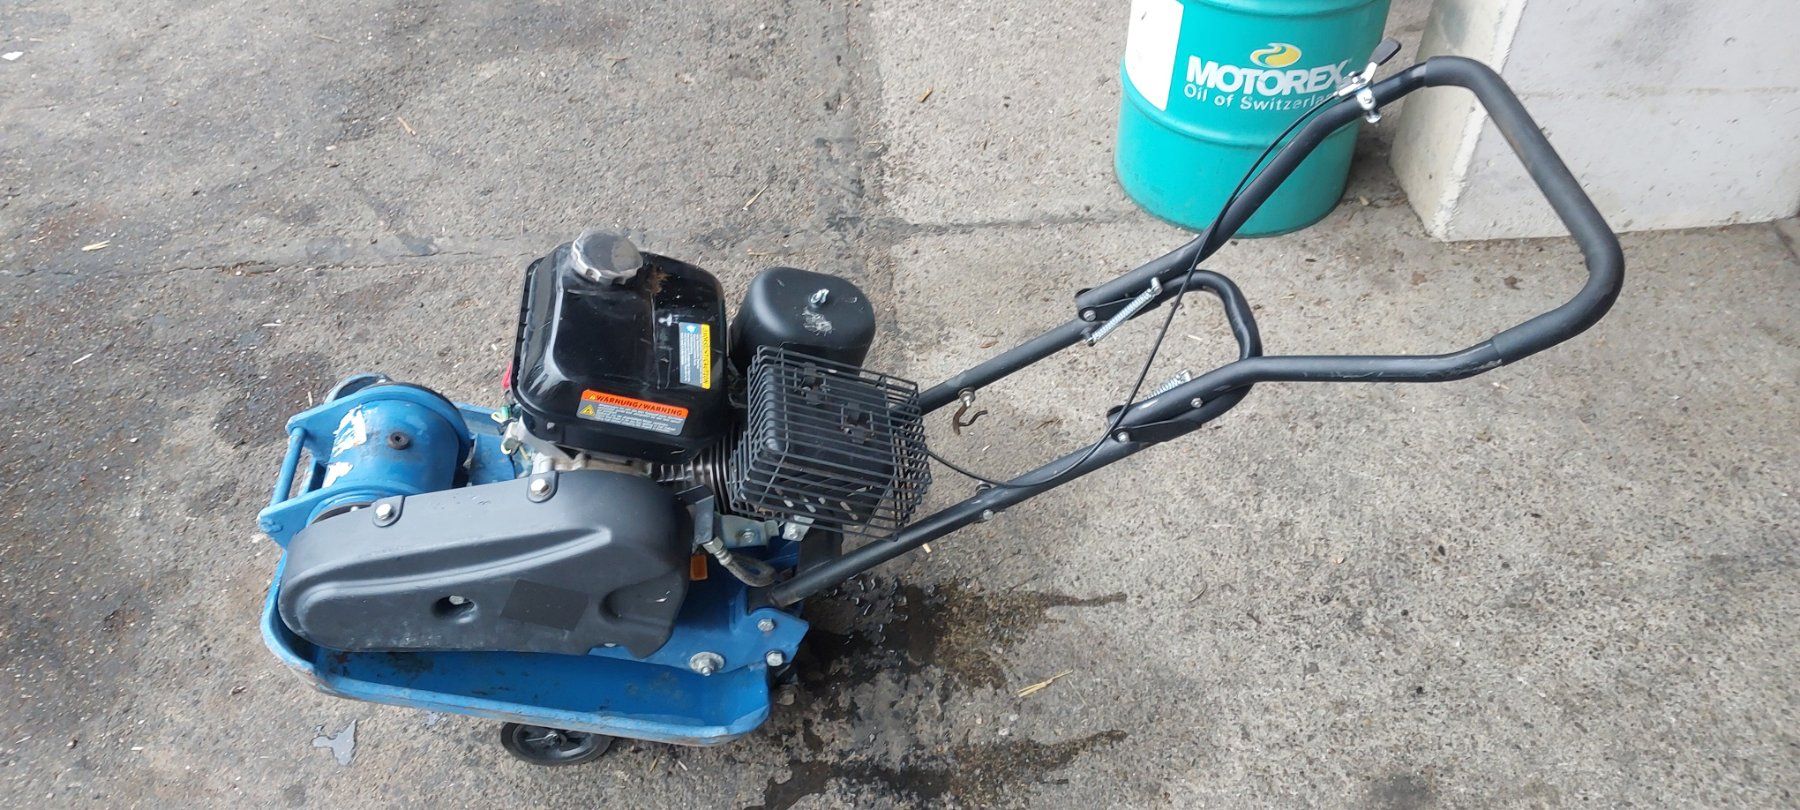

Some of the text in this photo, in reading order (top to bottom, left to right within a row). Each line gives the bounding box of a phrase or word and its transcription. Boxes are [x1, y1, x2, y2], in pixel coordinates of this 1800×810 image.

[1186, 55, 1348, 96] MOTOREX
[1184, 83, 1208, 102] Oil
[1214, 93, 1234, 107] of
